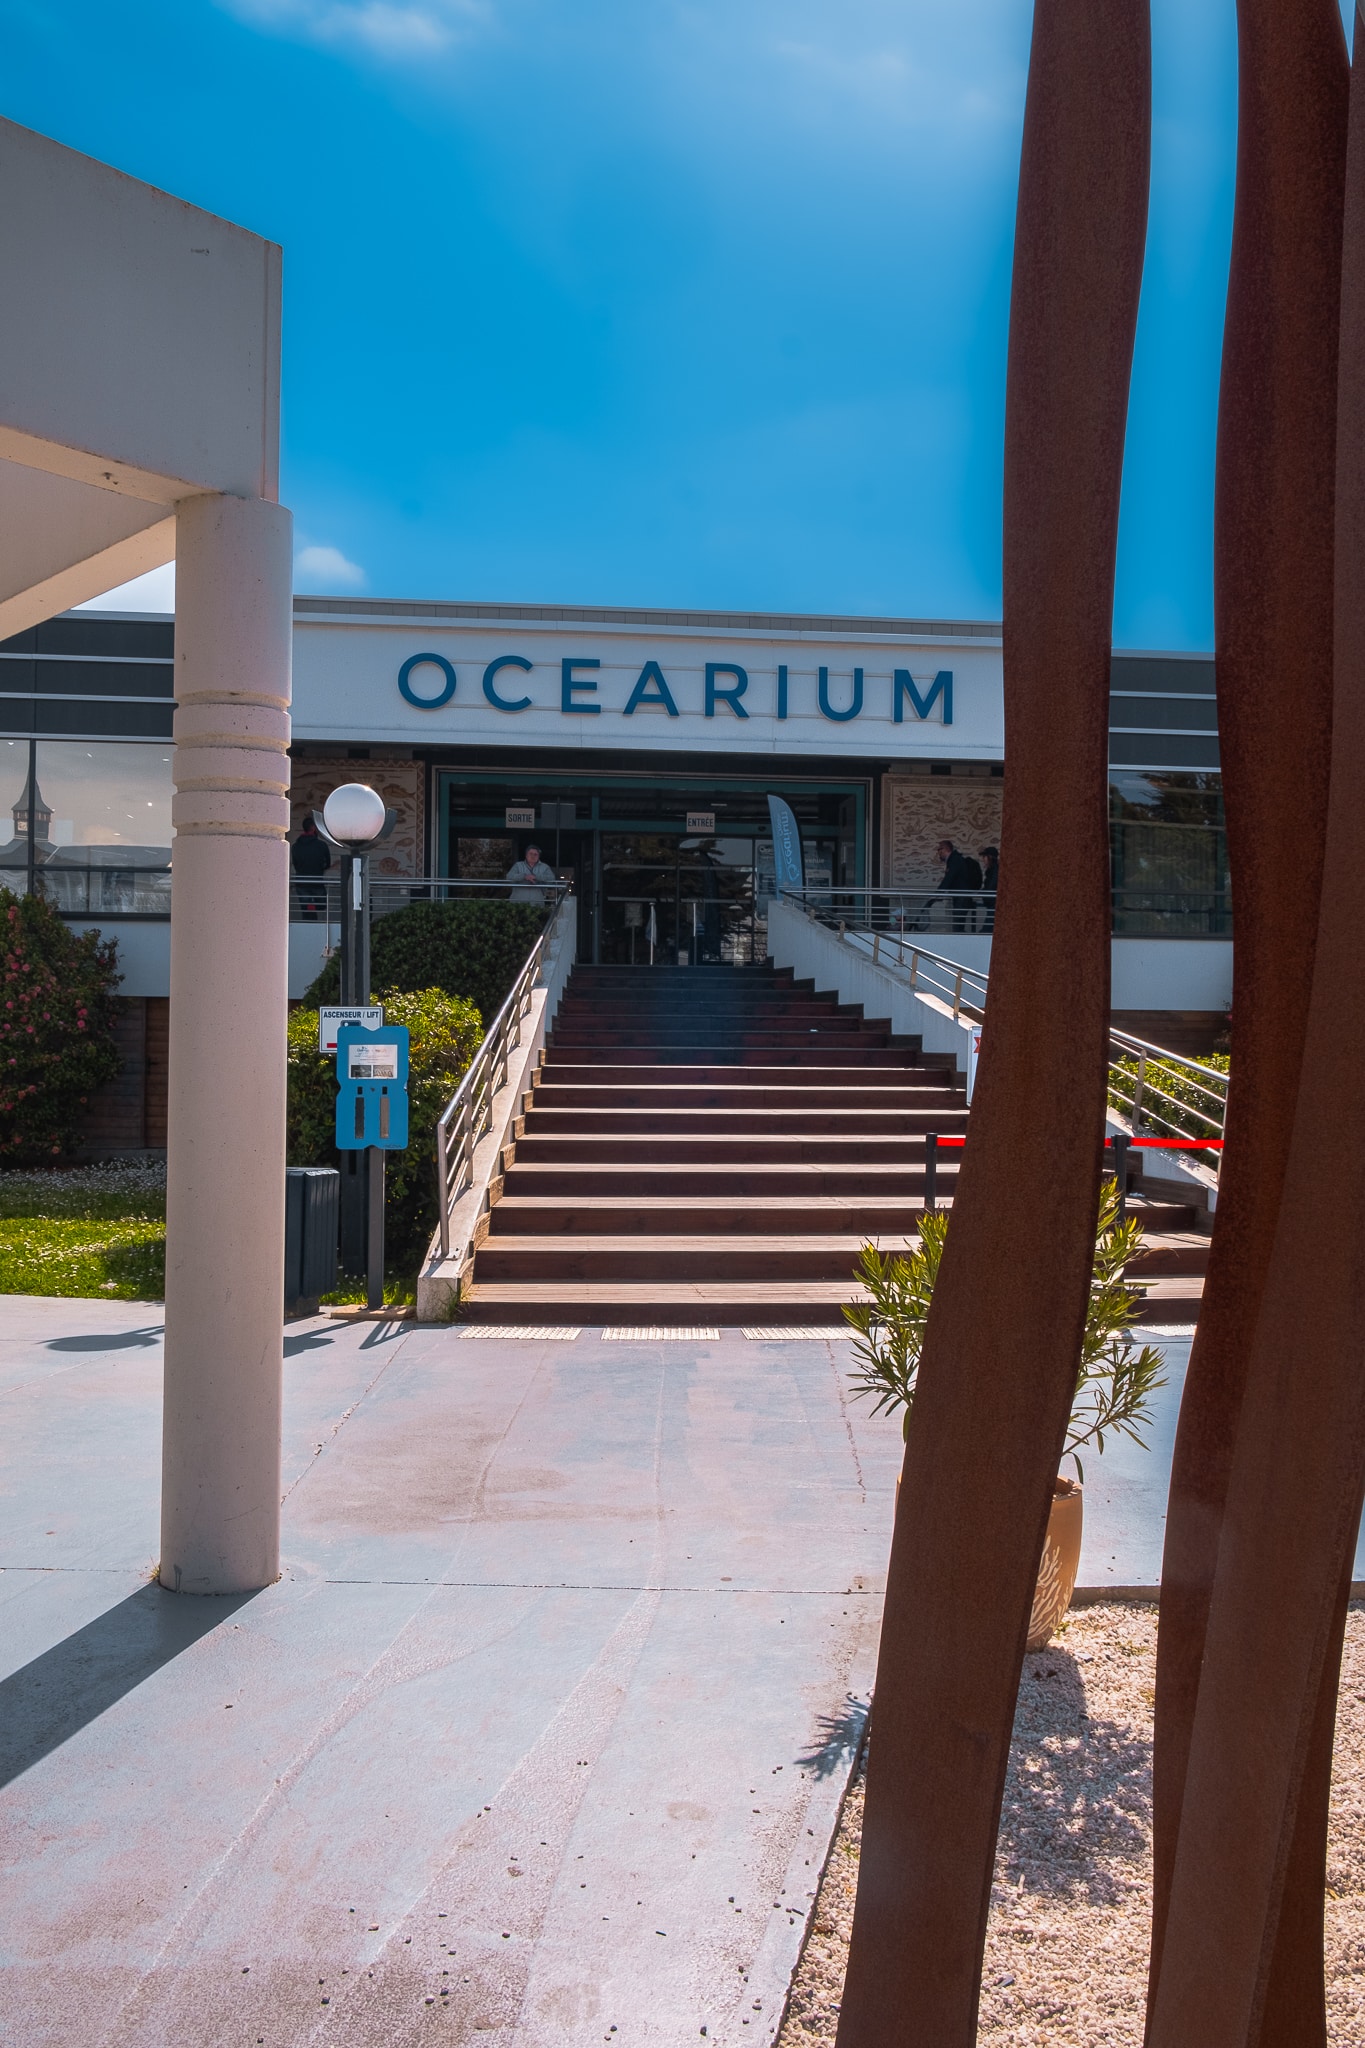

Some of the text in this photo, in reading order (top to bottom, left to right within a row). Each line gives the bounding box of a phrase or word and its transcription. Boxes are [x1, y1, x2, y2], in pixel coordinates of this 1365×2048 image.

[397, 652, 953, 725] OCEARIUM
[507, 813, 533, 823] SORTIE
[687, 817, 714, 828] ENTRÉE
[323, 1011, 362, 1019] ASCENSEUR
[366, 1011, 380, 1019] LIFT
